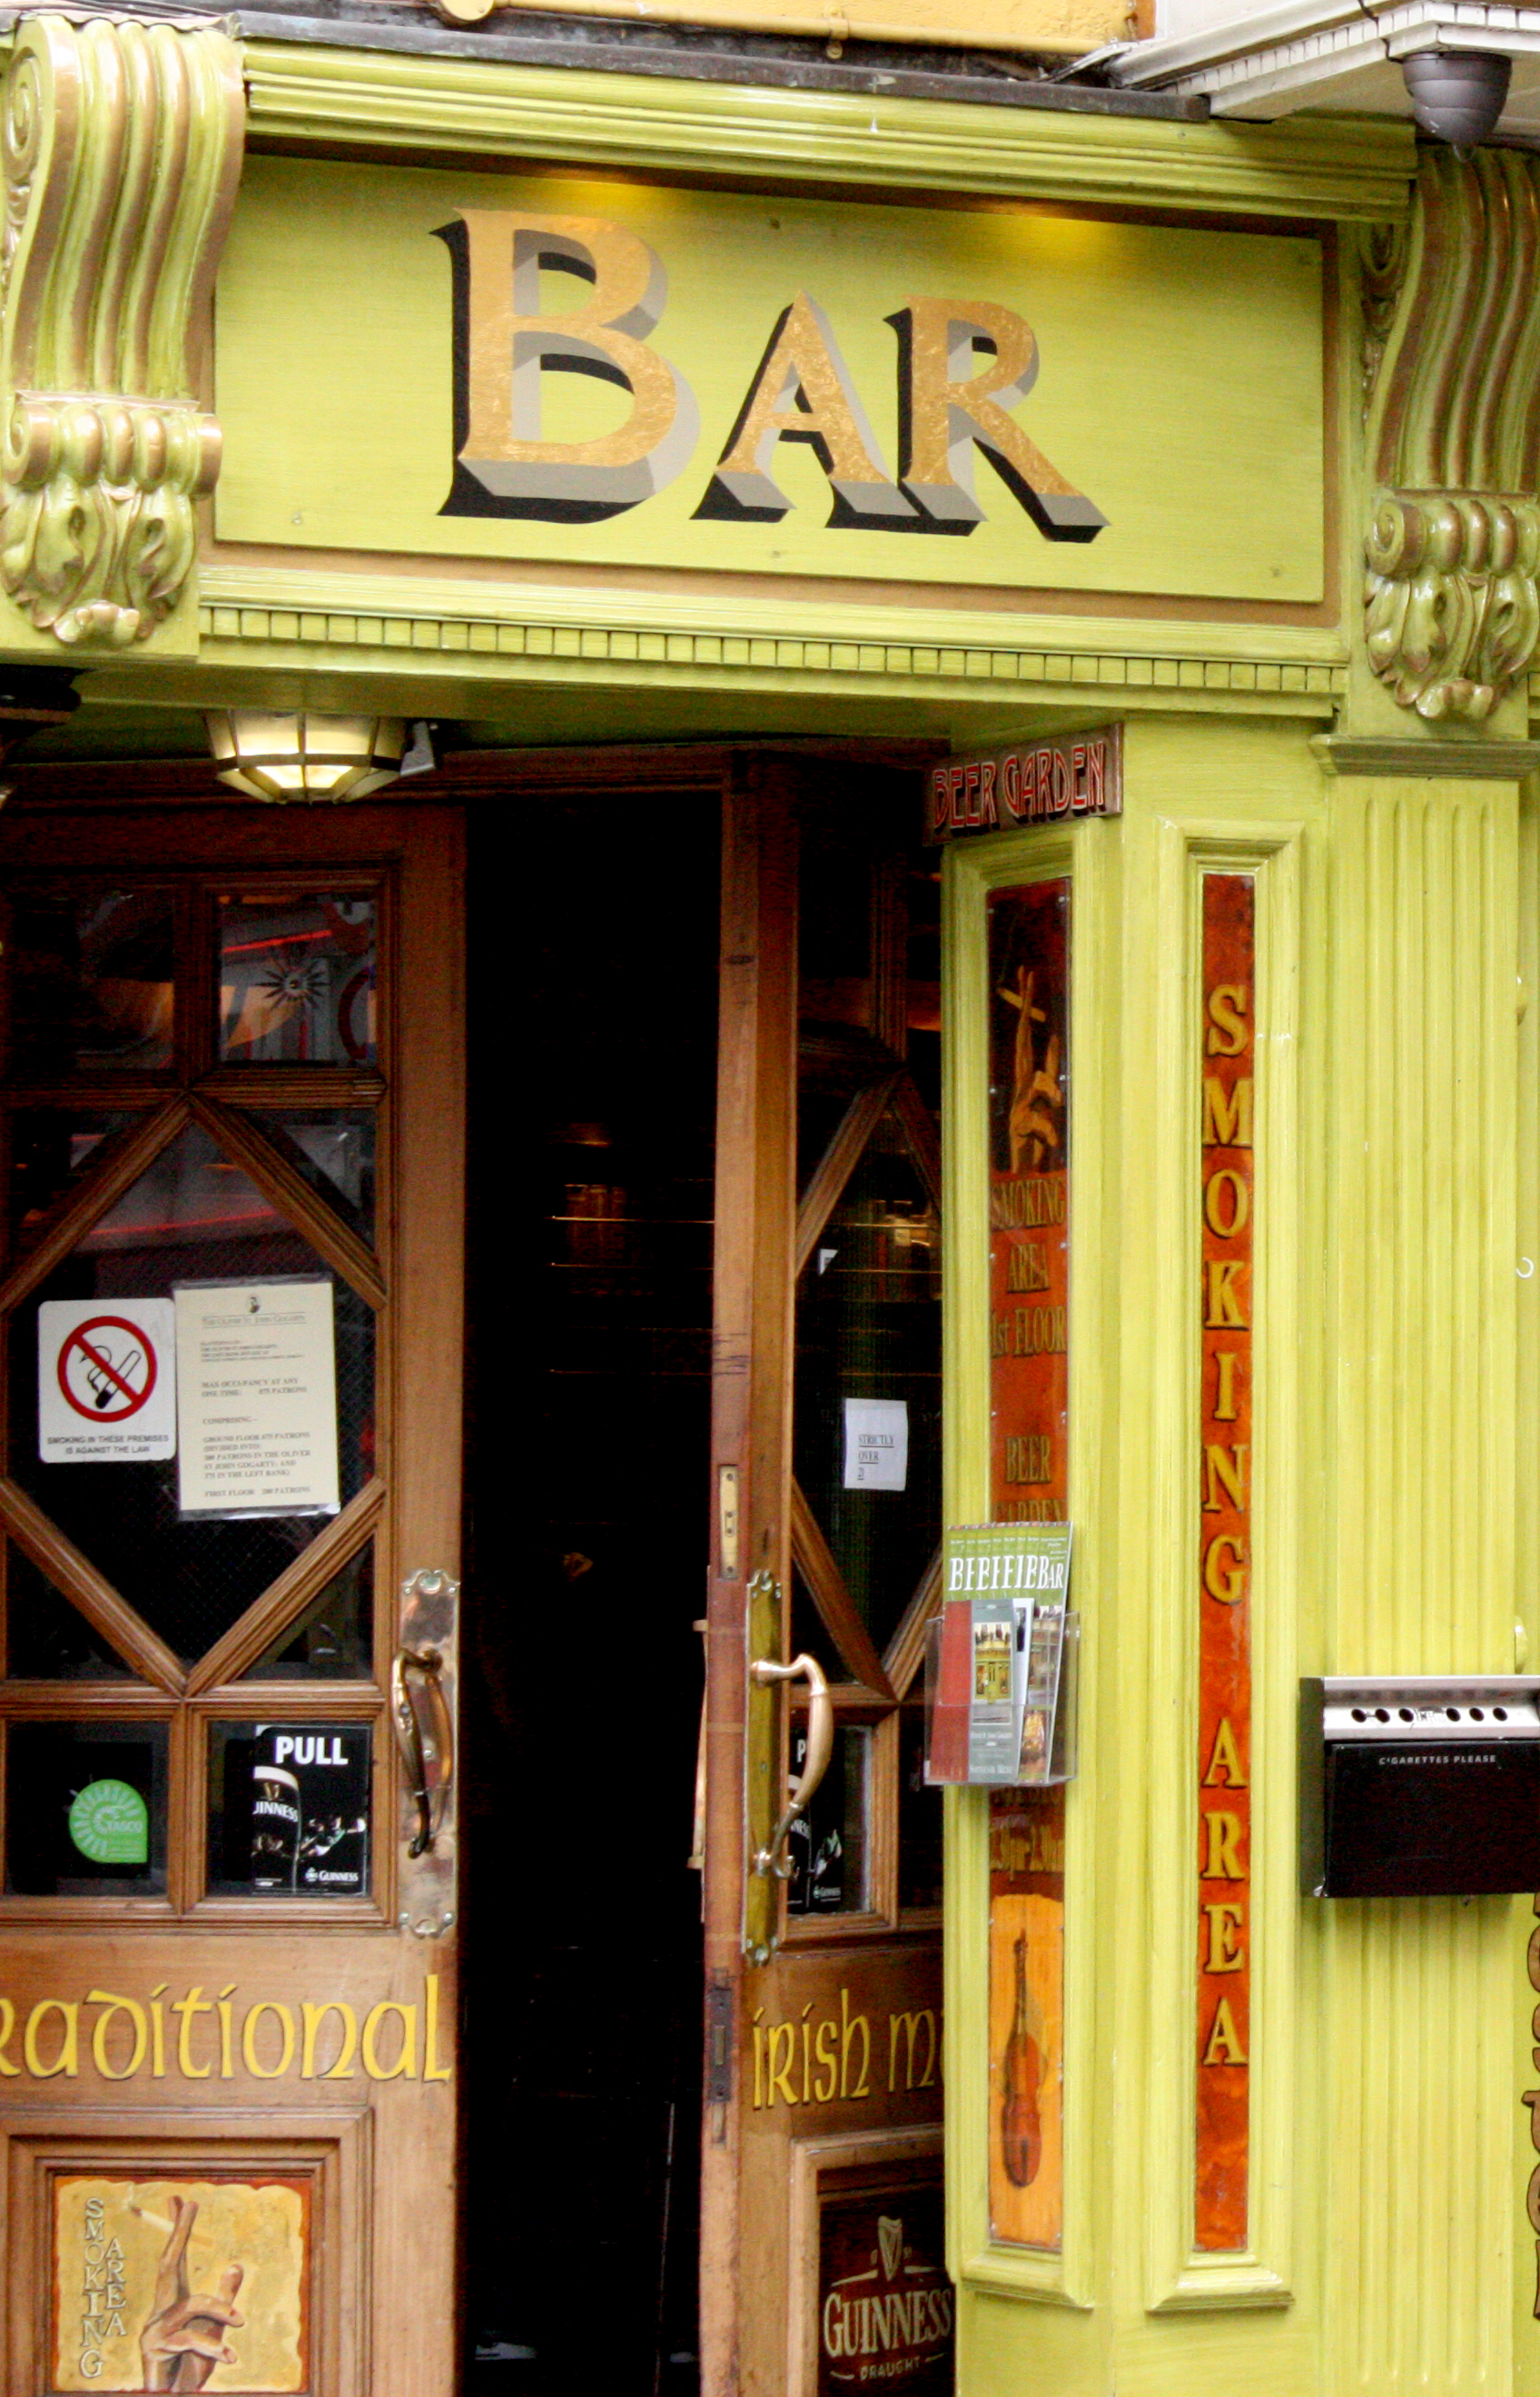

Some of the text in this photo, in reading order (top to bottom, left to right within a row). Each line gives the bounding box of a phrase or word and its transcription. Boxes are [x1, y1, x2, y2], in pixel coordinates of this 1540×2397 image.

[430, 208, 1110, 542] BAR
[933, 740, 1104, 829] BEER GARDEN
[1008, 1244, 1050, 1291] AREA
[1202, 983, 1253, 1605] SMOKING
[47, 1436, 86, 1445] SMOKING
[127, 1435, 169, 1443] PREMISES
[1006, 1435, 1051, 1485] BEER
[275, 1735, 349, 1765] PULL
[1454, 1755, 1496, 1763] PLEASE
[319, 1869, 359, 1882] GUINNESS
[1201, 1718, 1248, 2067] AREA
[79, 2196, 105, 2379] SMOKING
[104, 2237, 127, 2337] AREA
[824, 2292, 952, 2358] GUINNESS
[859, 2355, 921, 2381] DRAUGHT
